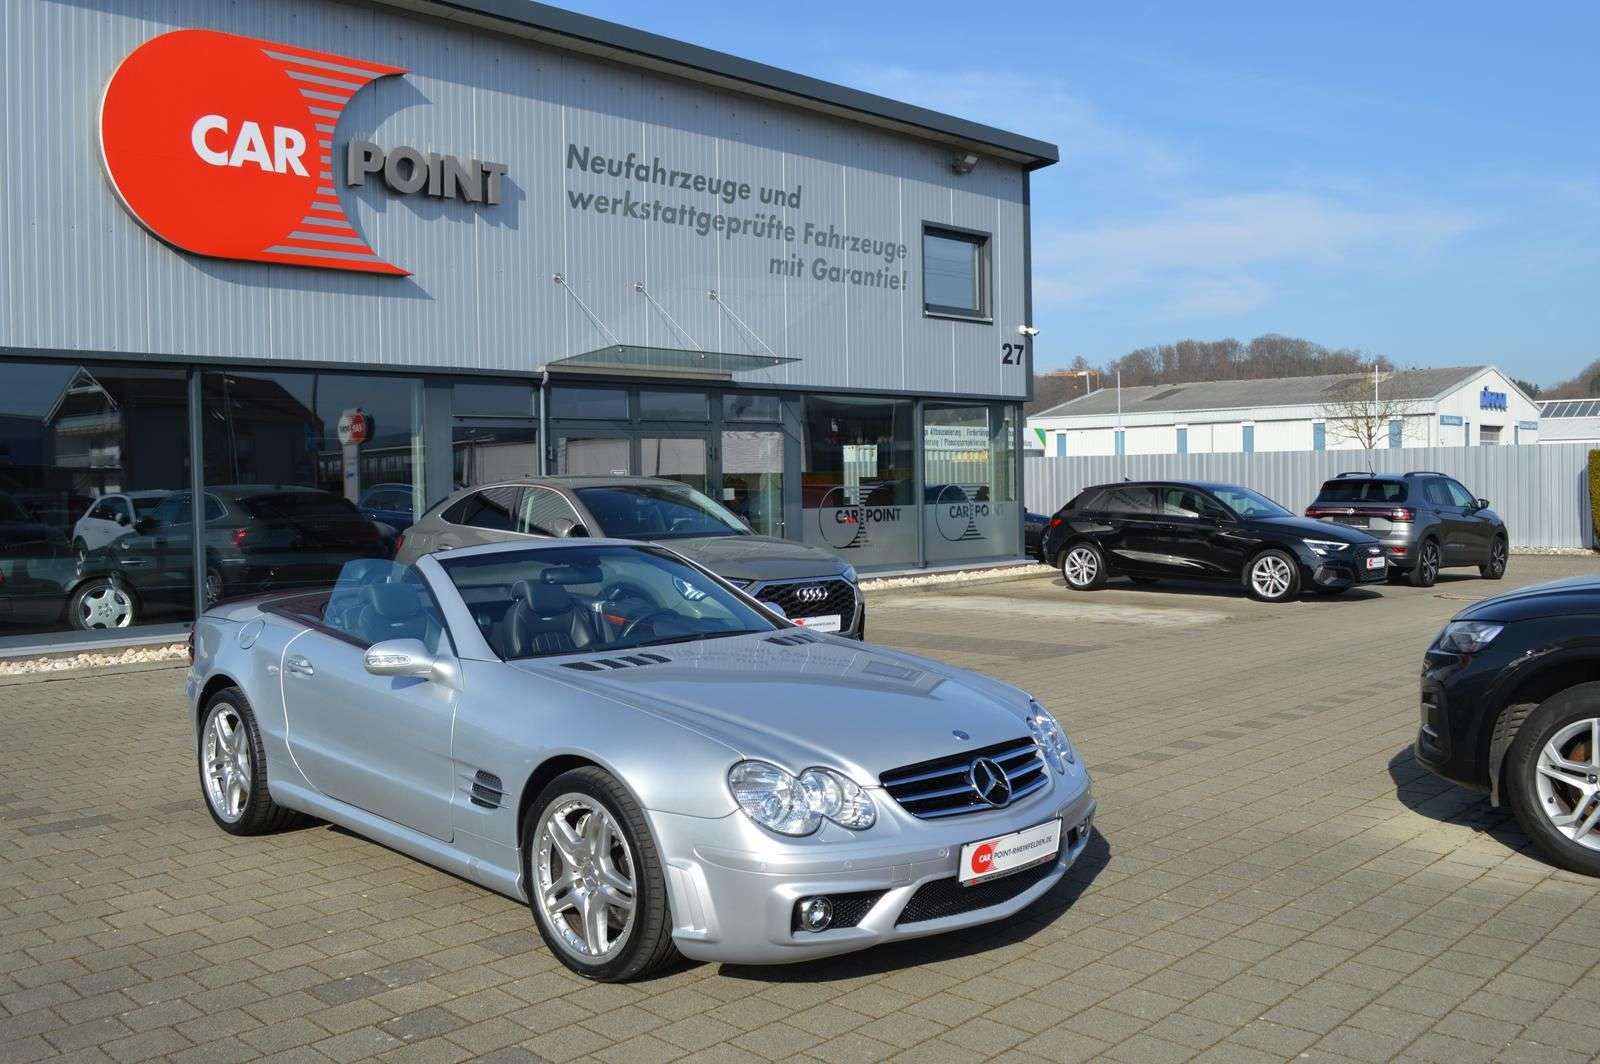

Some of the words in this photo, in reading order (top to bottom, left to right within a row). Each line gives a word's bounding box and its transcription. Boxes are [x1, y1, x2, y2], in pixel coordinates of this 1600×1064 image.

[191, 115, 310, 177] CAR
[346, 140, 509, 205] POINT
[566, 144, 752, 202] Neufahrzeuge
[759, 186, 802, 209] und
[567, 191, 797, 243] werkstattgeprüfte
[803, 222, 907, 262] Fahrzeuge
[769, 255, 804, 279] mit
[812, 258, 907, 291] Garantie!
[1002, 343, 1025, 366] 27
[836, 510, 860, 525] CAR
[867, 508, 901, 524] POINT
[949, 506, 968, 517] CAR
[979, 853, 992, 863] CAR
